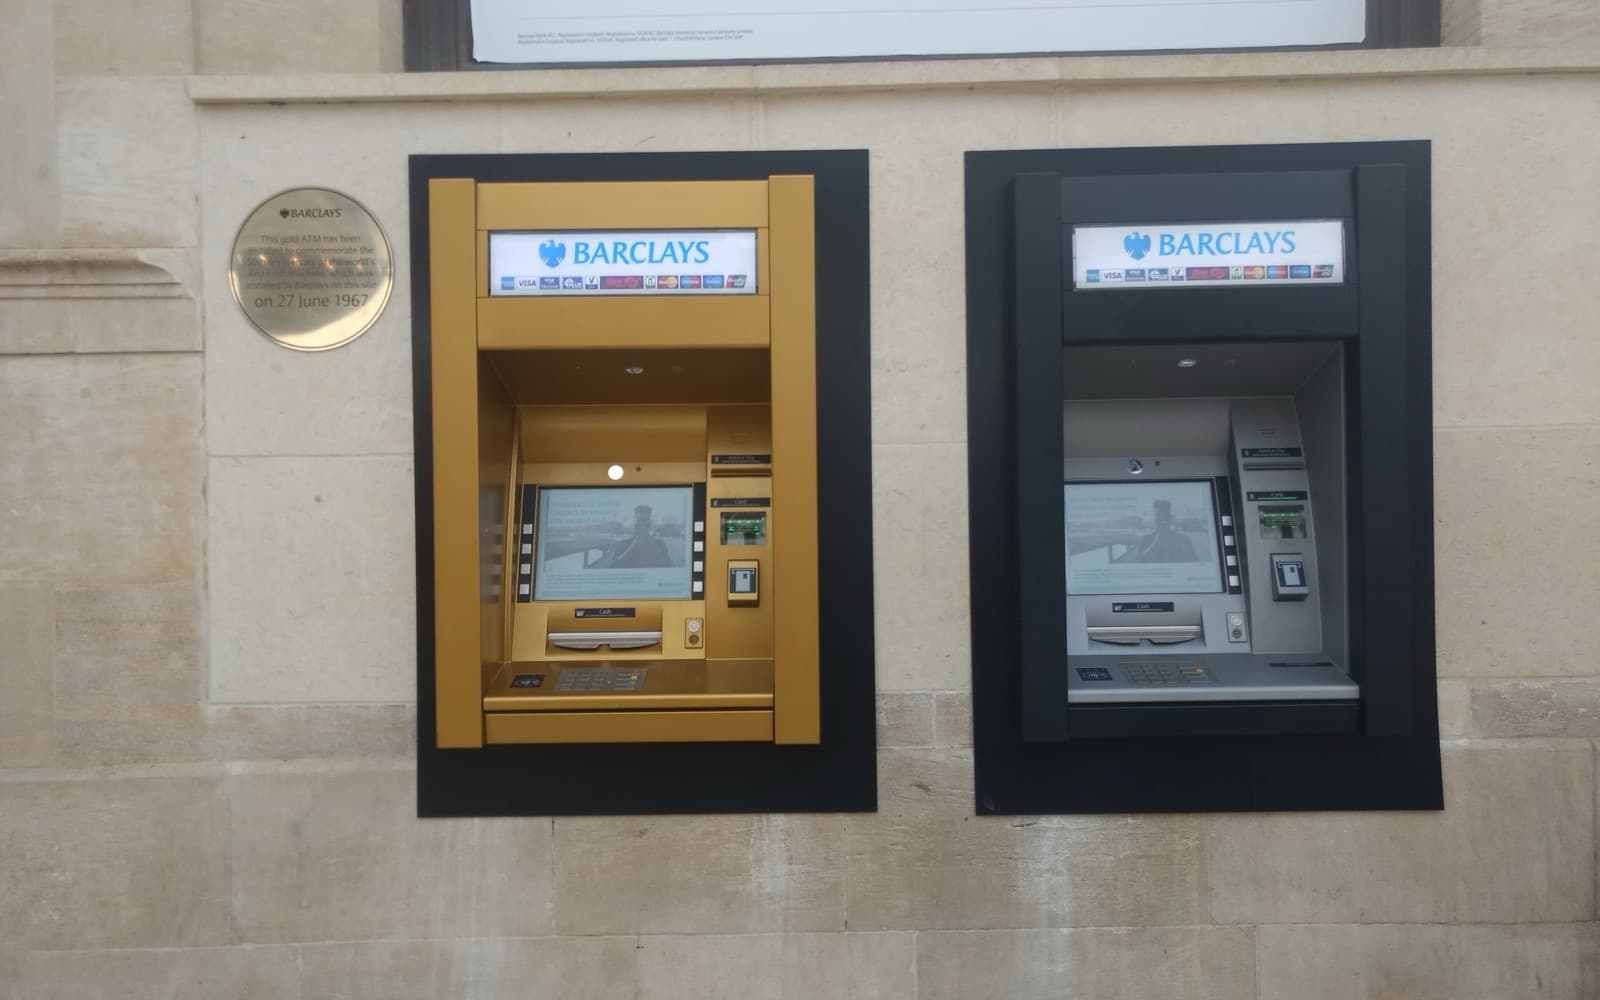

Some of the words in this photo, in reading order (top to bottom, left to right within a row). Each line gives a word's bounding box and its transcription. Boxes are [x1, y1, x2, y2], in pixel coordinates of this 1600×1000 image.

[291, 208, 342, 218] BARCLAYS
[261, 235, 279, 244] This
[302, 235, 321, 243] ATM
[323, 235, 338, 244] has
[1158, 231, 1296, 257] BARCLAYS
[296, 247, 358, 255] commemorate
[573, 240, 710, 265] BARCLAYS
[254, 298, 273, 308] on
[278, 294, 295, 307] 27
[299, 295, 330, 309] June
[335, 294, 369, 307] 1967
